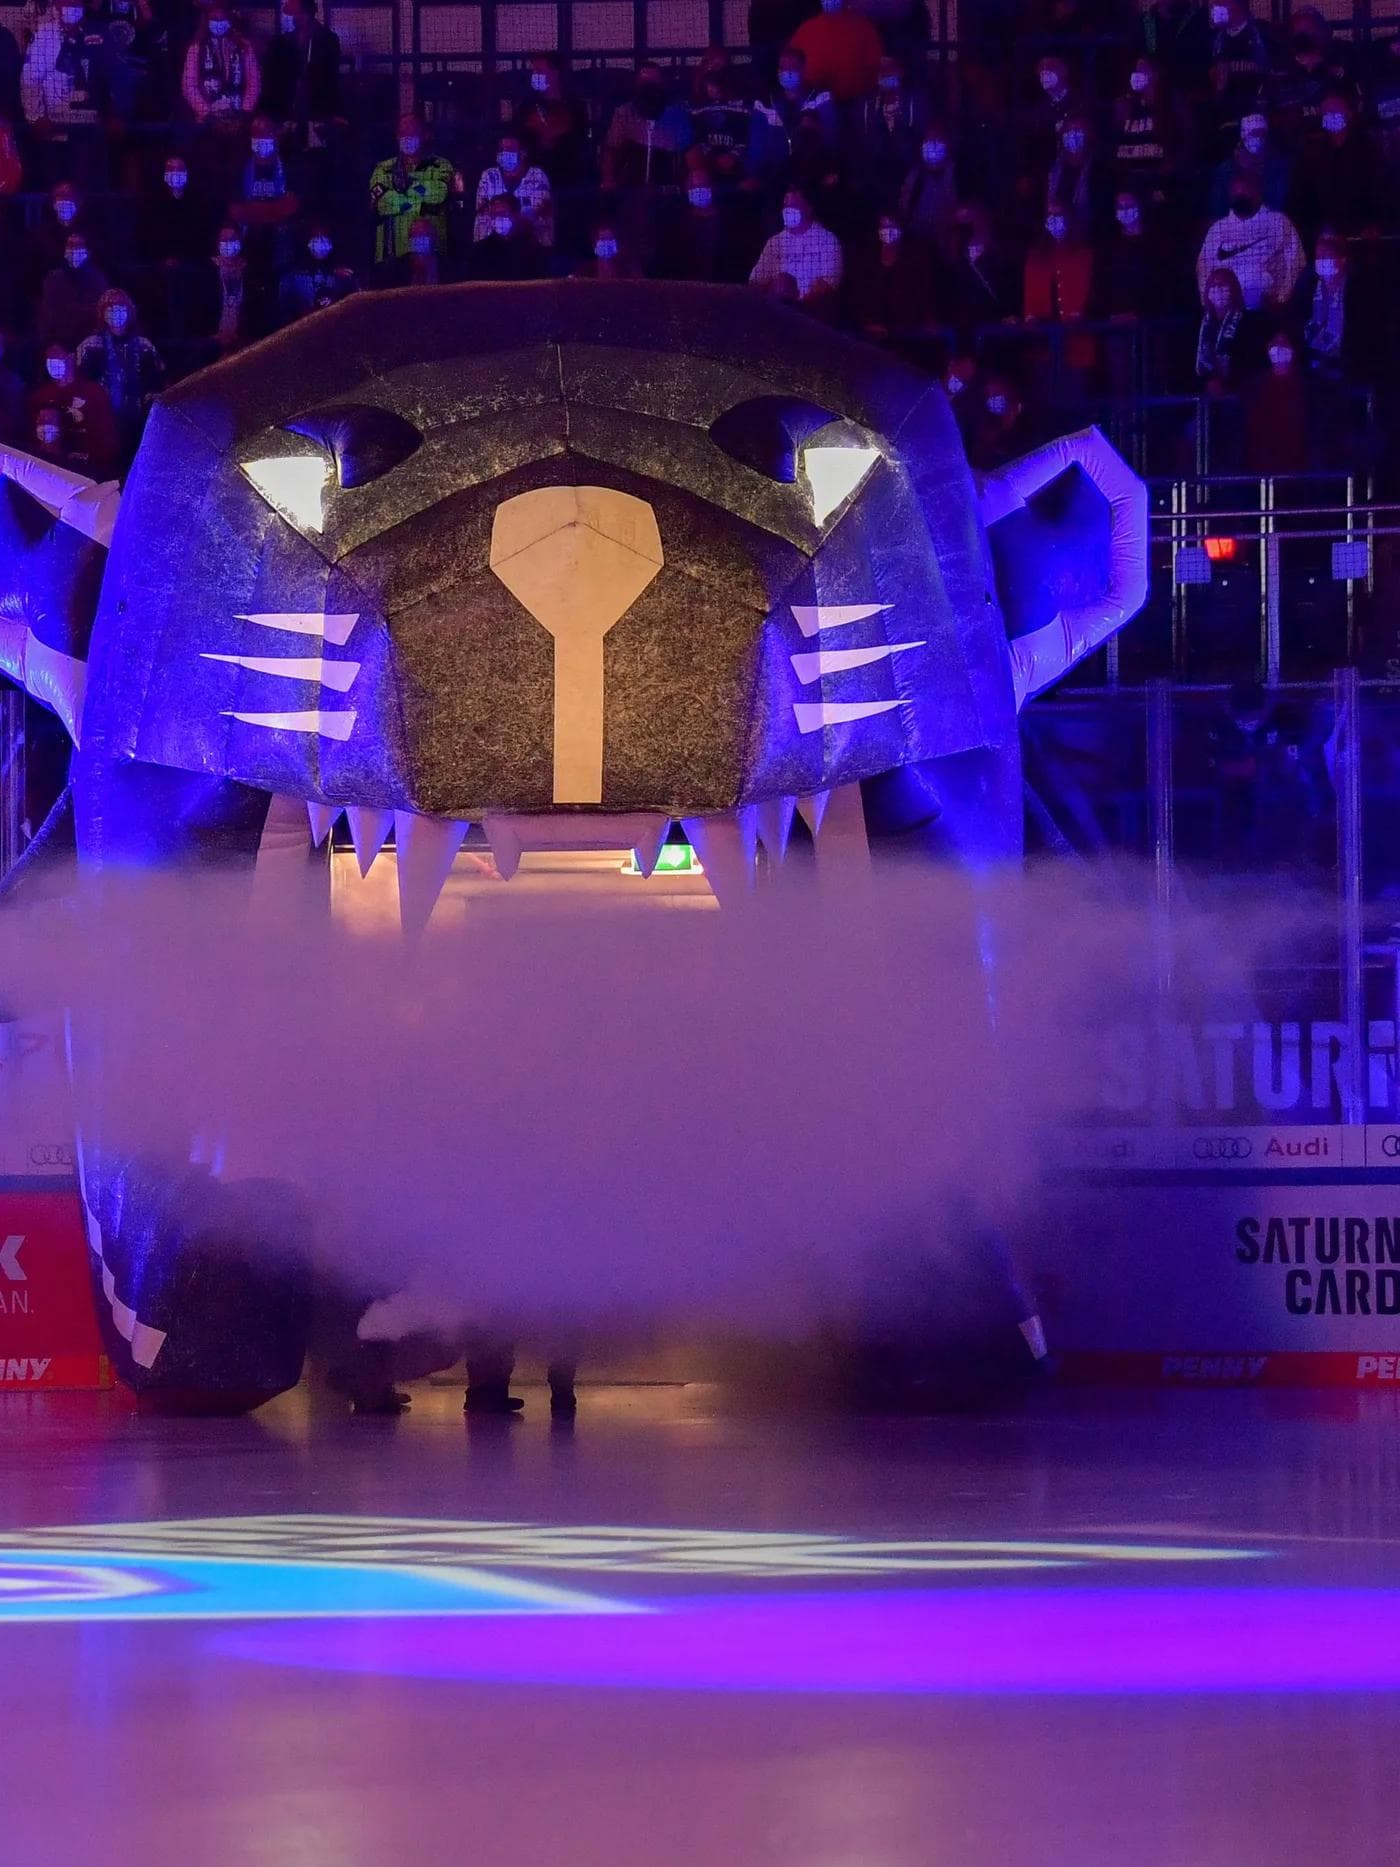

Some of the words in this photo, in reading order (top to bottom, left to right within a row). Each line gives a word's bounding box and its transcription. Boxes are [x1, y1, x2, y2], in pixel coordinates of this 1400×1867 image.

[1263, 1137, 1330, 1157] Audi
[1285, 1268, 1400, 1315] CARD
[1356, 1356, 1400, 1380] PE
